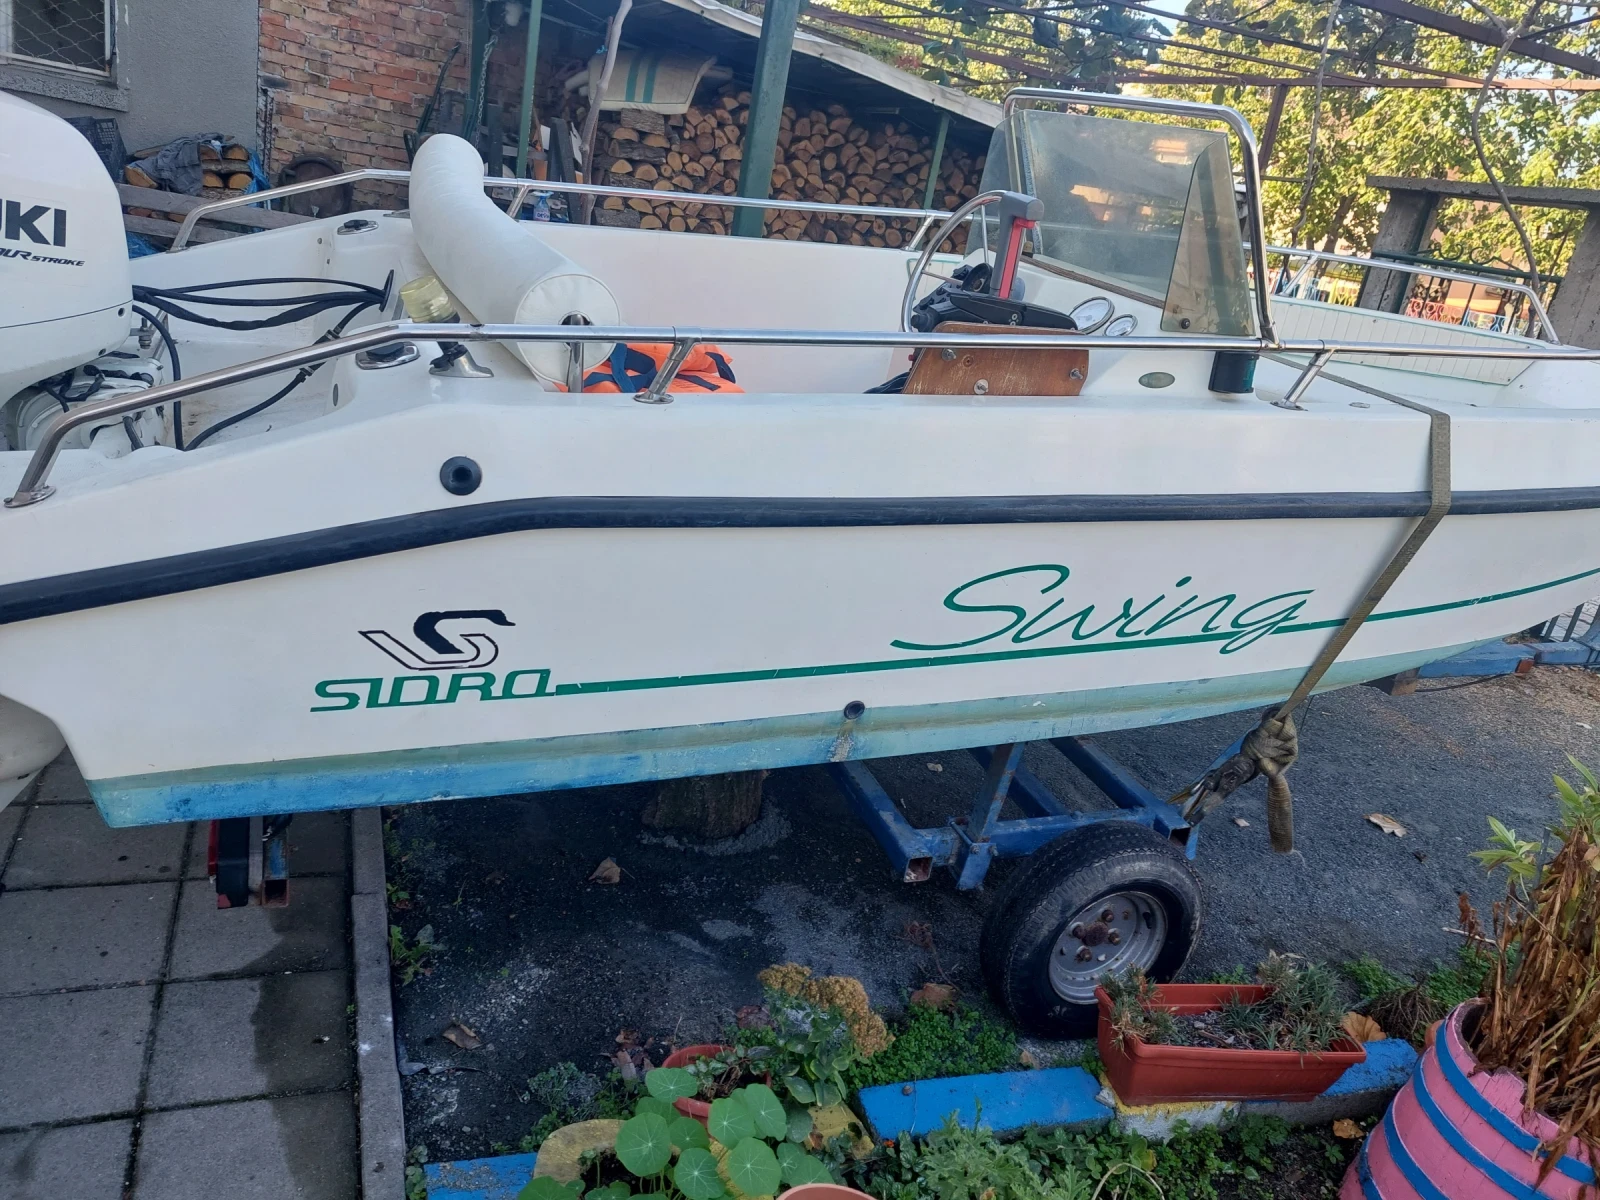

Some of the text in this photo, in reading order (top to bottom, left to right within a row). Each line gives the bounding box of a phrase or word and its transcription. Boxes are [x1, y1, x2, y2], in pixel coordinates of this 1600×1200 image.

[0, 198, 67, 247] KI
[31, 255, 86, 267] STROKE
[890, 564, 1315, 655] Swing
